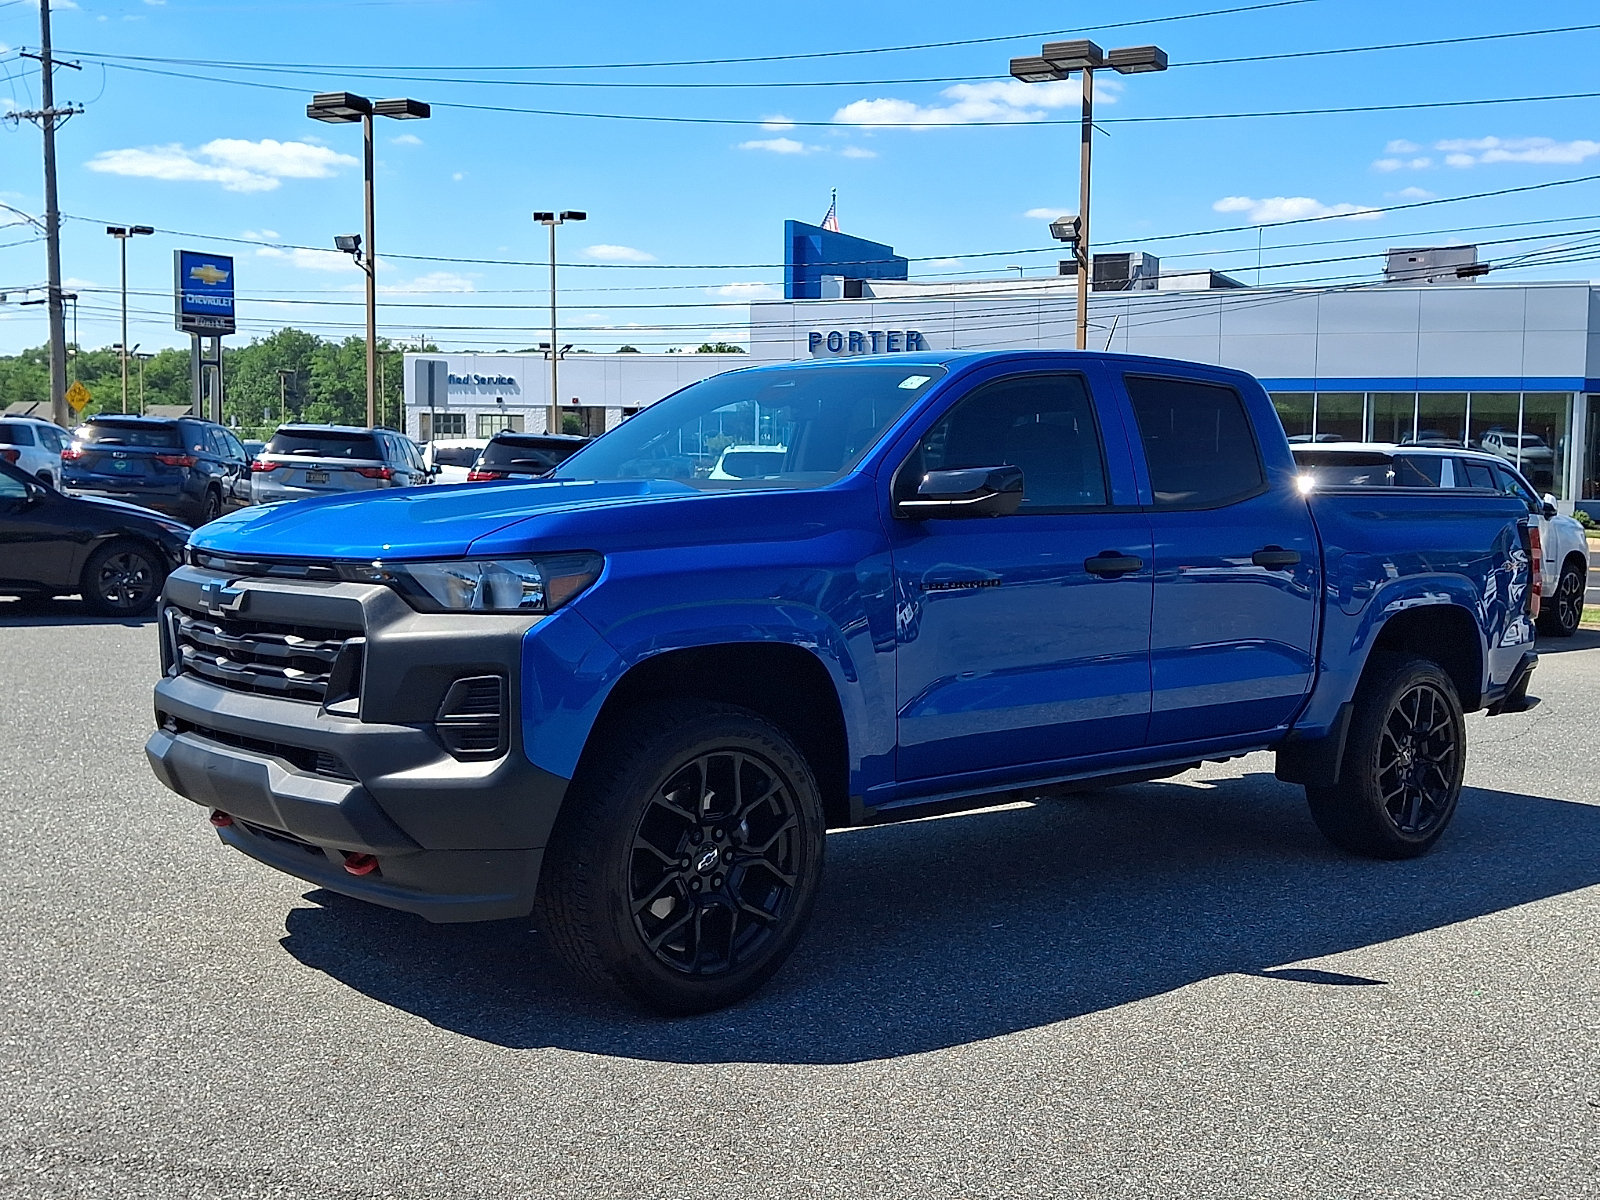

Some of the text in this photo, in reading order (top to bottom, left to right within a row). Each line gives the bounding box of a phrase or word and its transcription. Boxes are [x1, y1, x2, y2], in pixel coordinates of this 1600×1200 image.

[186, 293, 232, 307] CHEVROLET
[808, 330, 922, 353] PORTER
[473, 374, 514, 385] Service
